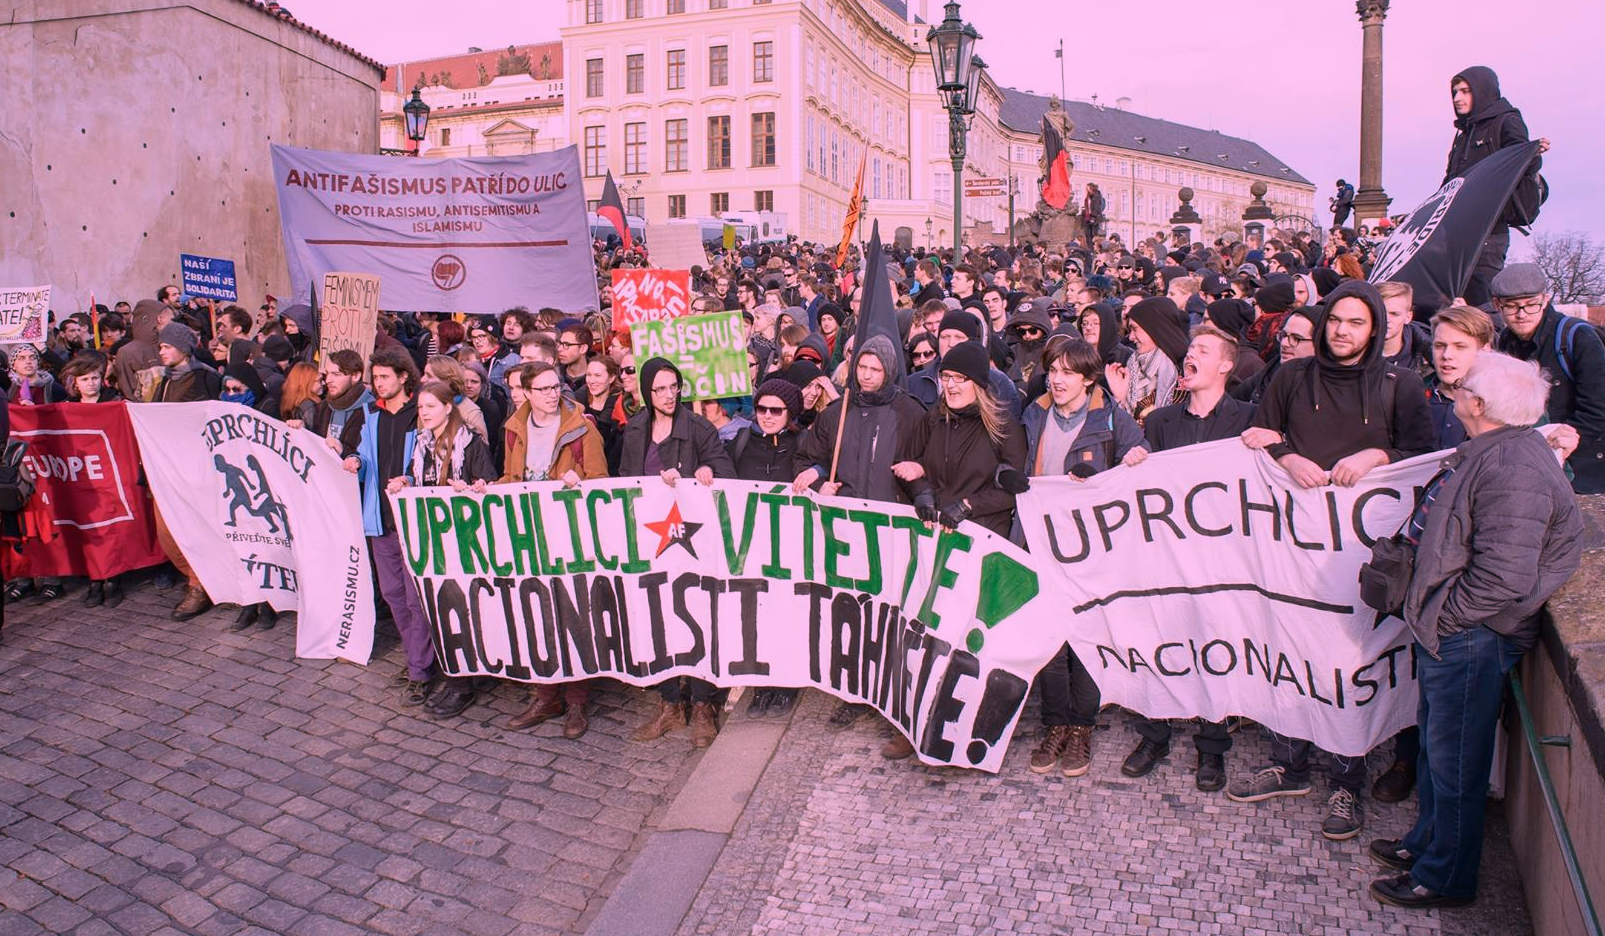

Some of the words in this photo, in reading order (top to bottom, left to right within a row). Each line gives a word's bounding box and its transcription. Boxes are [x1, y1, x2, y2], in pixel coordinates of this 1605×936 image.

[286, 169, 446, 196] ANTIFAŠISMUS
[451, 171, 505, 195] PATŘÍ
[506, 176, 530, 194] DO
[533, 172, 567, 193] ULIC
[335, 204, 374, 217] PROTI
[444, 205, 531, 217] ANTISEMITISMU
[532, 203, 541, 214] A
[412, 220, 483, 233] ISLAMISMU
[184, 258, 212, 270] NAŠÍ
[222, 277, 235, 287] JE
[0, 289, 50, 305] TERMINATE
[185, 283, 237, 299] SOLIDARITA
[632, 313, 744, 357] FAŠISMUS
[667, 522, 686, 539] AF
[711, 484, 1041, 655] VÍTEJTE!
[336, 545, 360, 649] NERASISMU.CZ
[413, 569, 770, 678] NACIONALISTI
